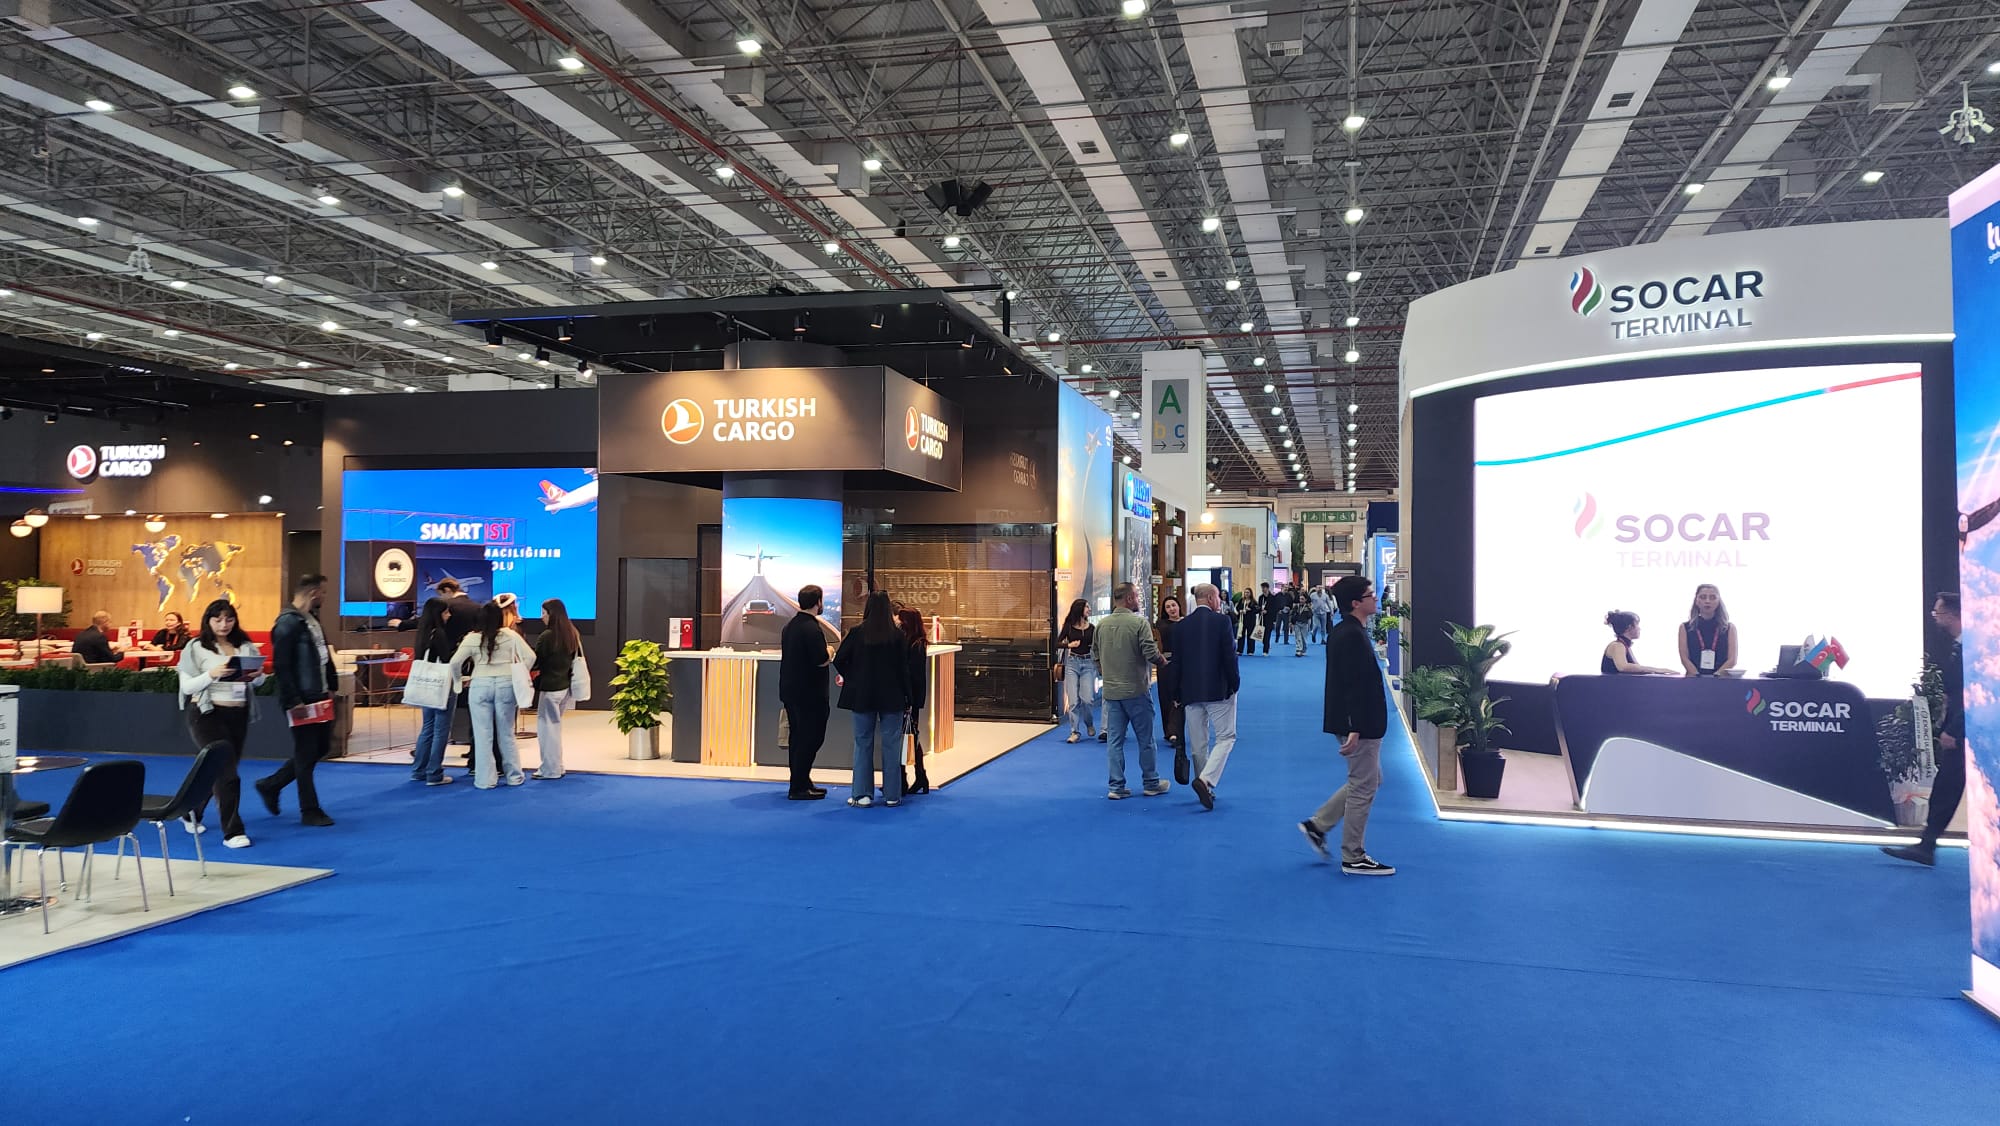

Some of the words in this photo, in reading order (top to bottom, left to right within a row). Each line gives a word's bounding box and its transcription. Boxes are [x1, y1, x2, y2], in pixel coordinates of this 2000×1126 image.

[1609, 270, 1764, 313] SOCAR
[1611, 307, 1753, 340] TERMINAL
[713, 397, 817, 419] TURKISH
[1158, 384, 1182, 415] A
[712, 420, 796, 442] CARGO
[920, 412, 949, 442] TURKISH
[99, 444, 166, 461] TURKISH
[920, 434, 944, 460] CARGO
[98, 460, 152, 477] CARGO
[1614, 512, 1771, 543] SOCAR
[1615, 550, 1748, 569] TERMINAL
[887, 591, 941, 604] ARGO
[1768, 701, 1851, 719] SOCAR
[1769, 720, 1845, 733] TERMINAL
